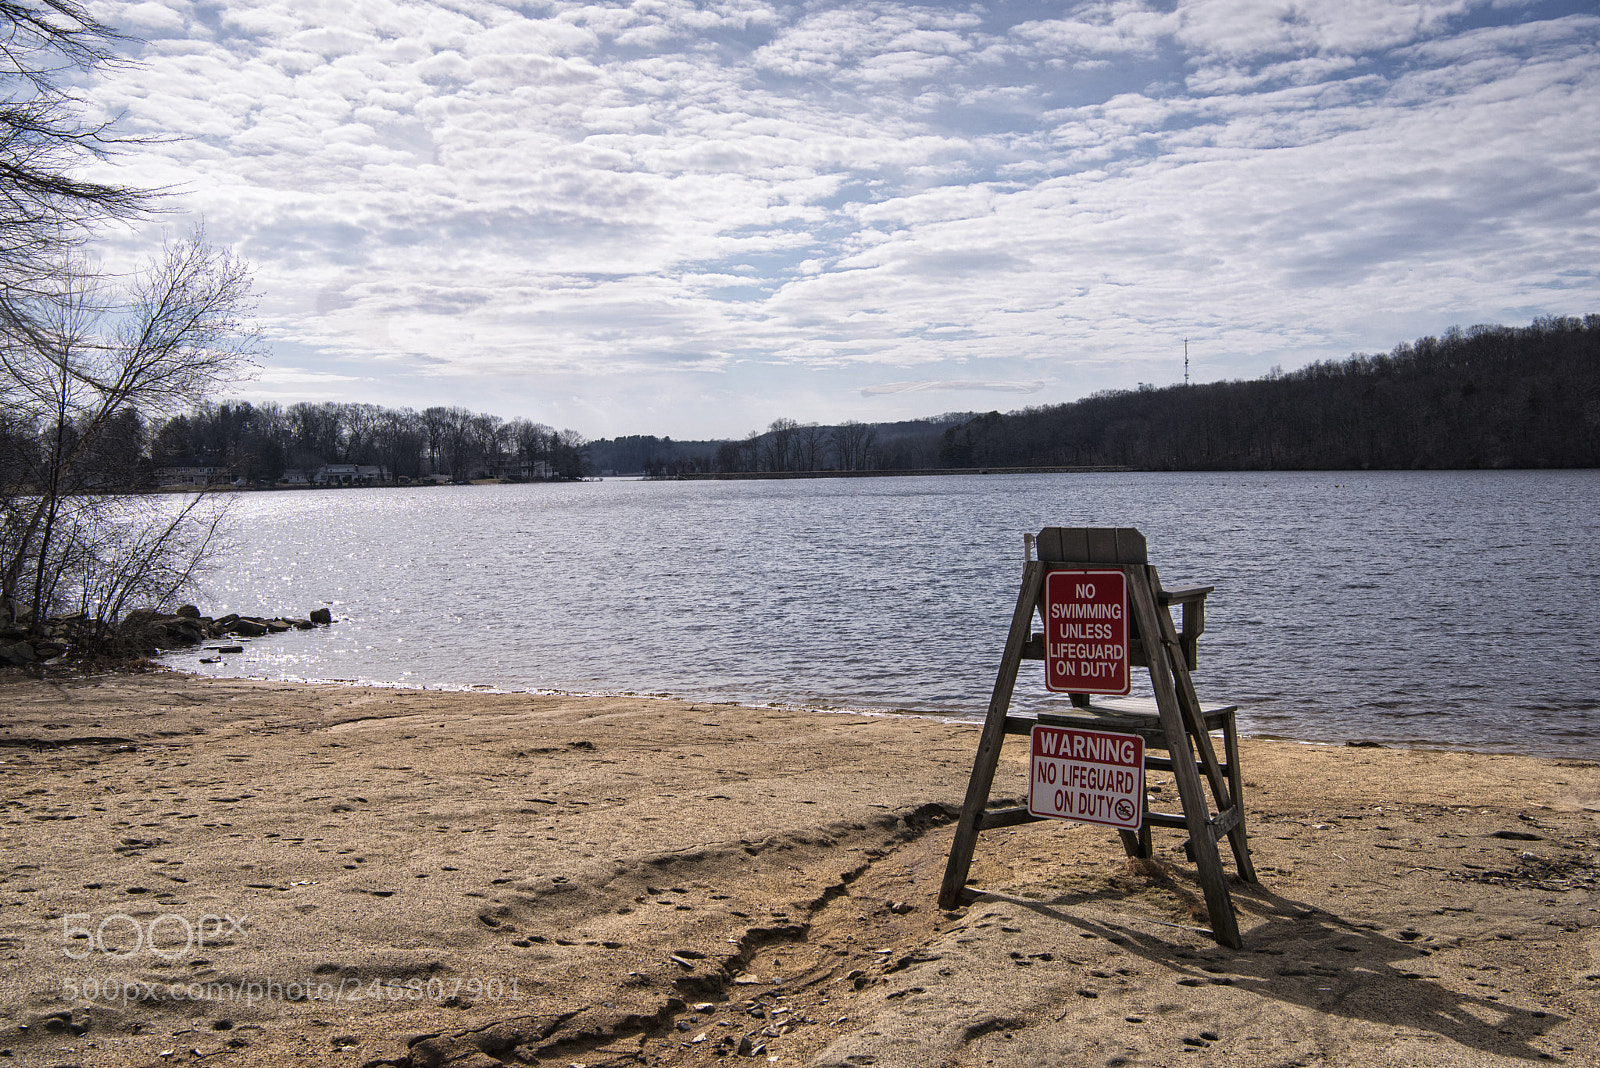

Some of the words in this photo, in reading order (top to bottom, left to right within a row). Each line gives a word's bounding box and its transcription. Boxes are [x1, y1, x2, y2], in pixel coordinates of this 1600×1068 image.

[1075, 583, 1096, 599] NO
[1051, 603, 1122, 619] SWIMMING
[1060, 623, 1113, 639] UNLESS
[1050, 643, 1124, 660] LIFEGUARD
[1056, 661, 1076, 676] ON
[1081, 662, 1118, 678] DUTY
[1040, 731, 1135, 764] WARNING
[1037, 761, 1057, 785] NO
[1062, 764, 1134, 794] LIFEGUARD
[1054, 789, 1073, 813] ON
[1078, 792, 1115, 818] DUTY
